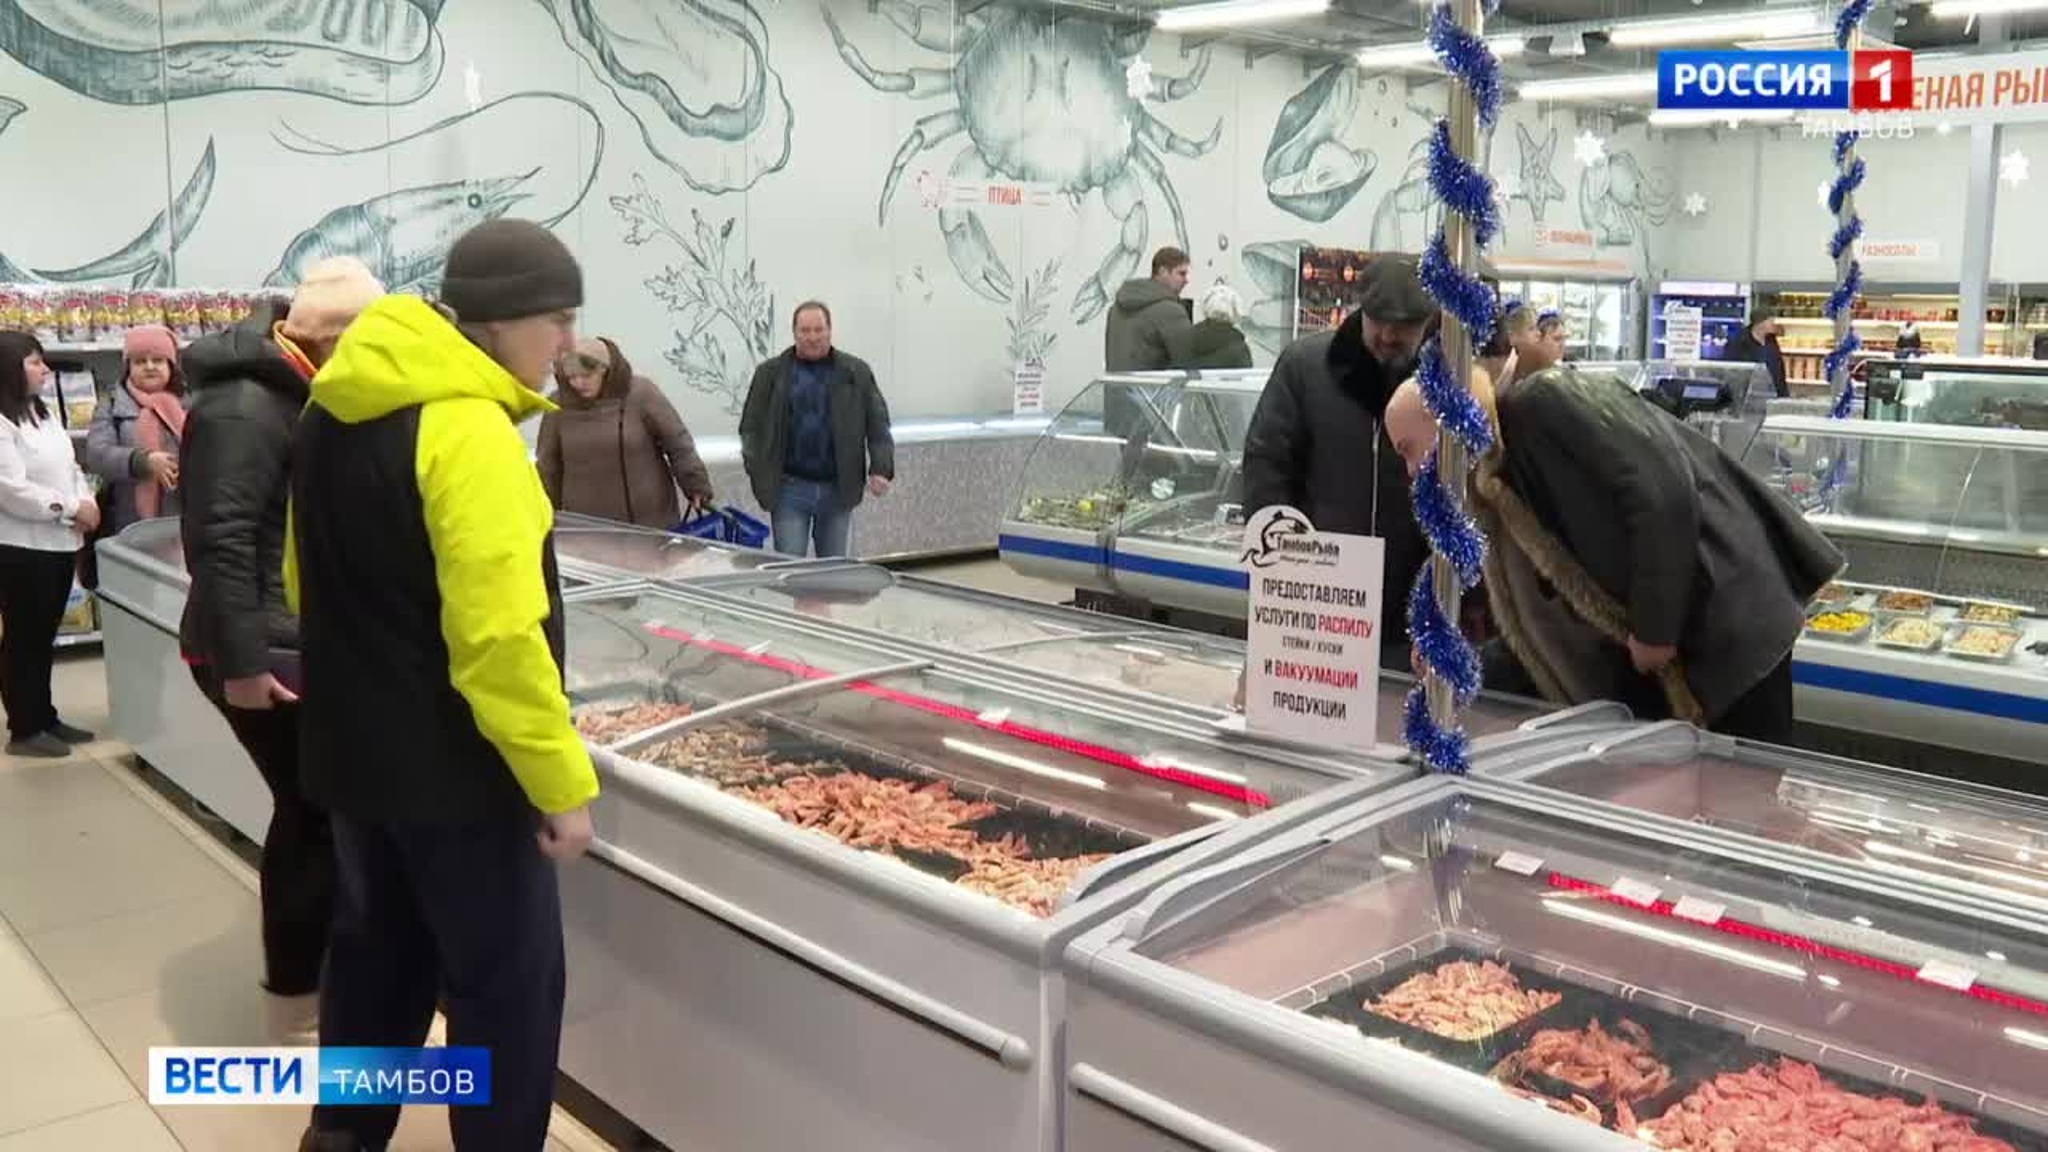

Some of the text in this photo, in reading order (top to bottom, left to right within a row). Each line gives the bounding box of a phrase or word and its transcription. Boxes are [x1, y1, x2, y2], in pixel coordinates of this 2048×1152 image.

[987, 186, 1023, 205] ПТИЦА
[1277, 534, 1340, 557] ТамбовРыба
[1262, 578, 1367, 608] ПРЕДОСТАВЛЯЕМ
[1254, 606, 1374, 639] УСЛУГИ ПО РАСПИЛУ
[1282, 635, 1310, 651] СТЕЙКИ
[1317, 640, 1343, 654] КУСКИ
[1264, 659, 1359, 690] И ВАКУУМАЦИИ
[1273, 691, 1347, 720] ПРОДУКЦИИ
